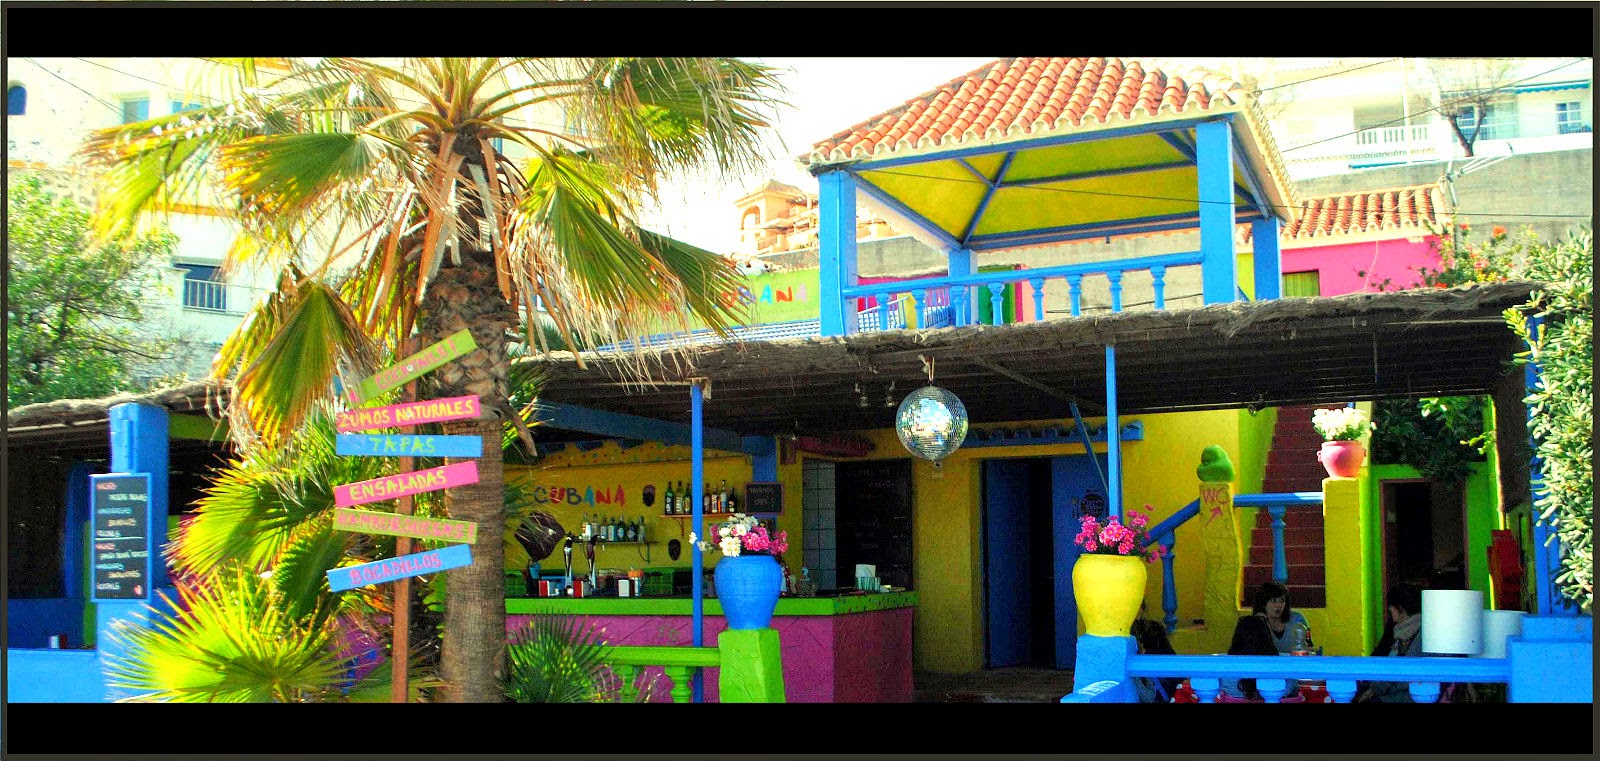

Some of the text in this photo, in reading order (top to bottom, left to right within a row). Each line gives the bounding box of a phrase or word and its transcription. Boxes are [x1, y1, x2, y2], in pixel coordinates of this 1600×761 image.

[339, 400, 474, 428] ZUMOS NATURALES
[368, 437, 436, 454] TAPAS
[349, 469, 448, 501] ENSALADAS
[534, 483, 625, 508] CUBANA
[349, 552, 442, 585] BOCADILLOS
